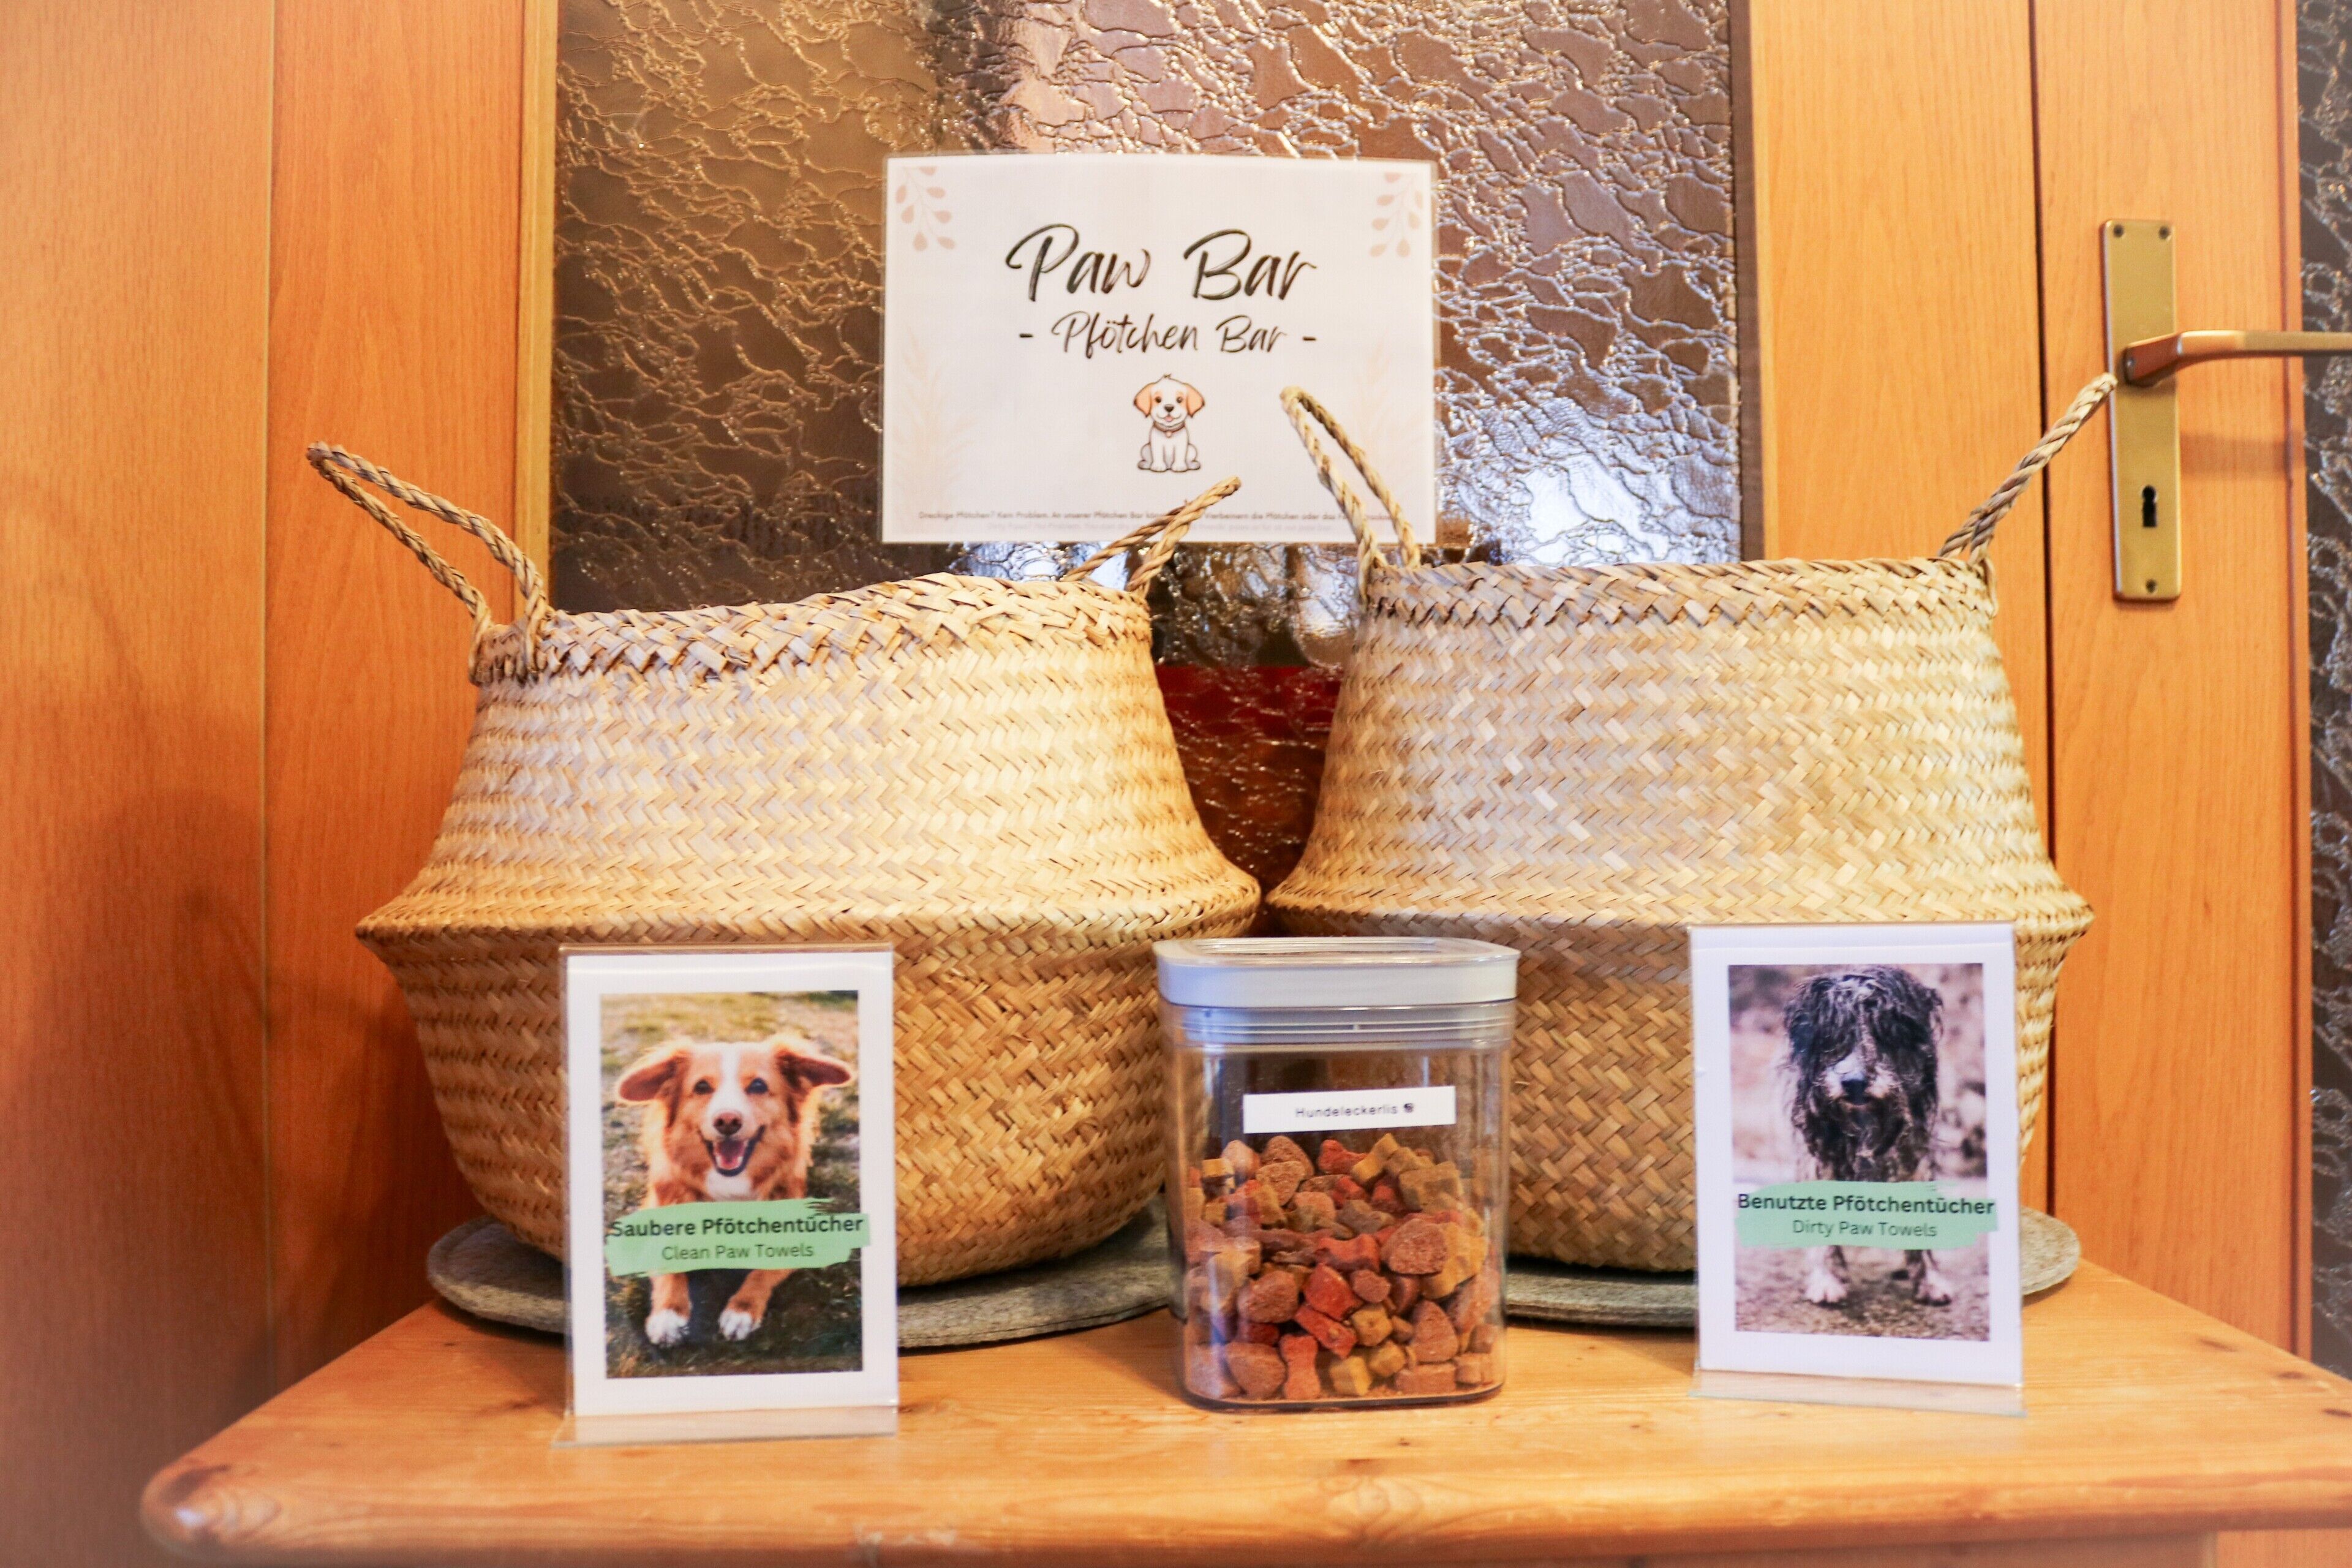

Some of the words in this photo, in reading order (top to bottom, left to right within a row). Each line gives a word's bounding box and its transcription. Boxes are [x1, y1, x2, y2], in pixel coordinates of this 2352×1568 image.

[1006, 224, 1151, 301] Paw
[1183, 228, 1317, 300] Bar
[1051, 311, 1199, 359] Pfötchen
[1215, 314, 1287, 353] Bar
[1295, 1103, 1398, 1118] Hundeleckerlis
[1738, 1194, 1826, 1210] Benutzte
[1833, 1195, 1996, 1215] Pfötchentücher
[612, 1218, 695, 1237] Saubere
[702, 1216, 864, 1235] Pfötchentücher
[1792, 1219, 1833, 1237] Dirty
[1839, 1221, 1872, 1236] Paw
[1878, 1222, 1937, 1237] Towels
[662, 1245, 710, 1260] Clean
[715, 1244, 749, 1259] Paw
[755, 1242, 815, 1257] Towels
